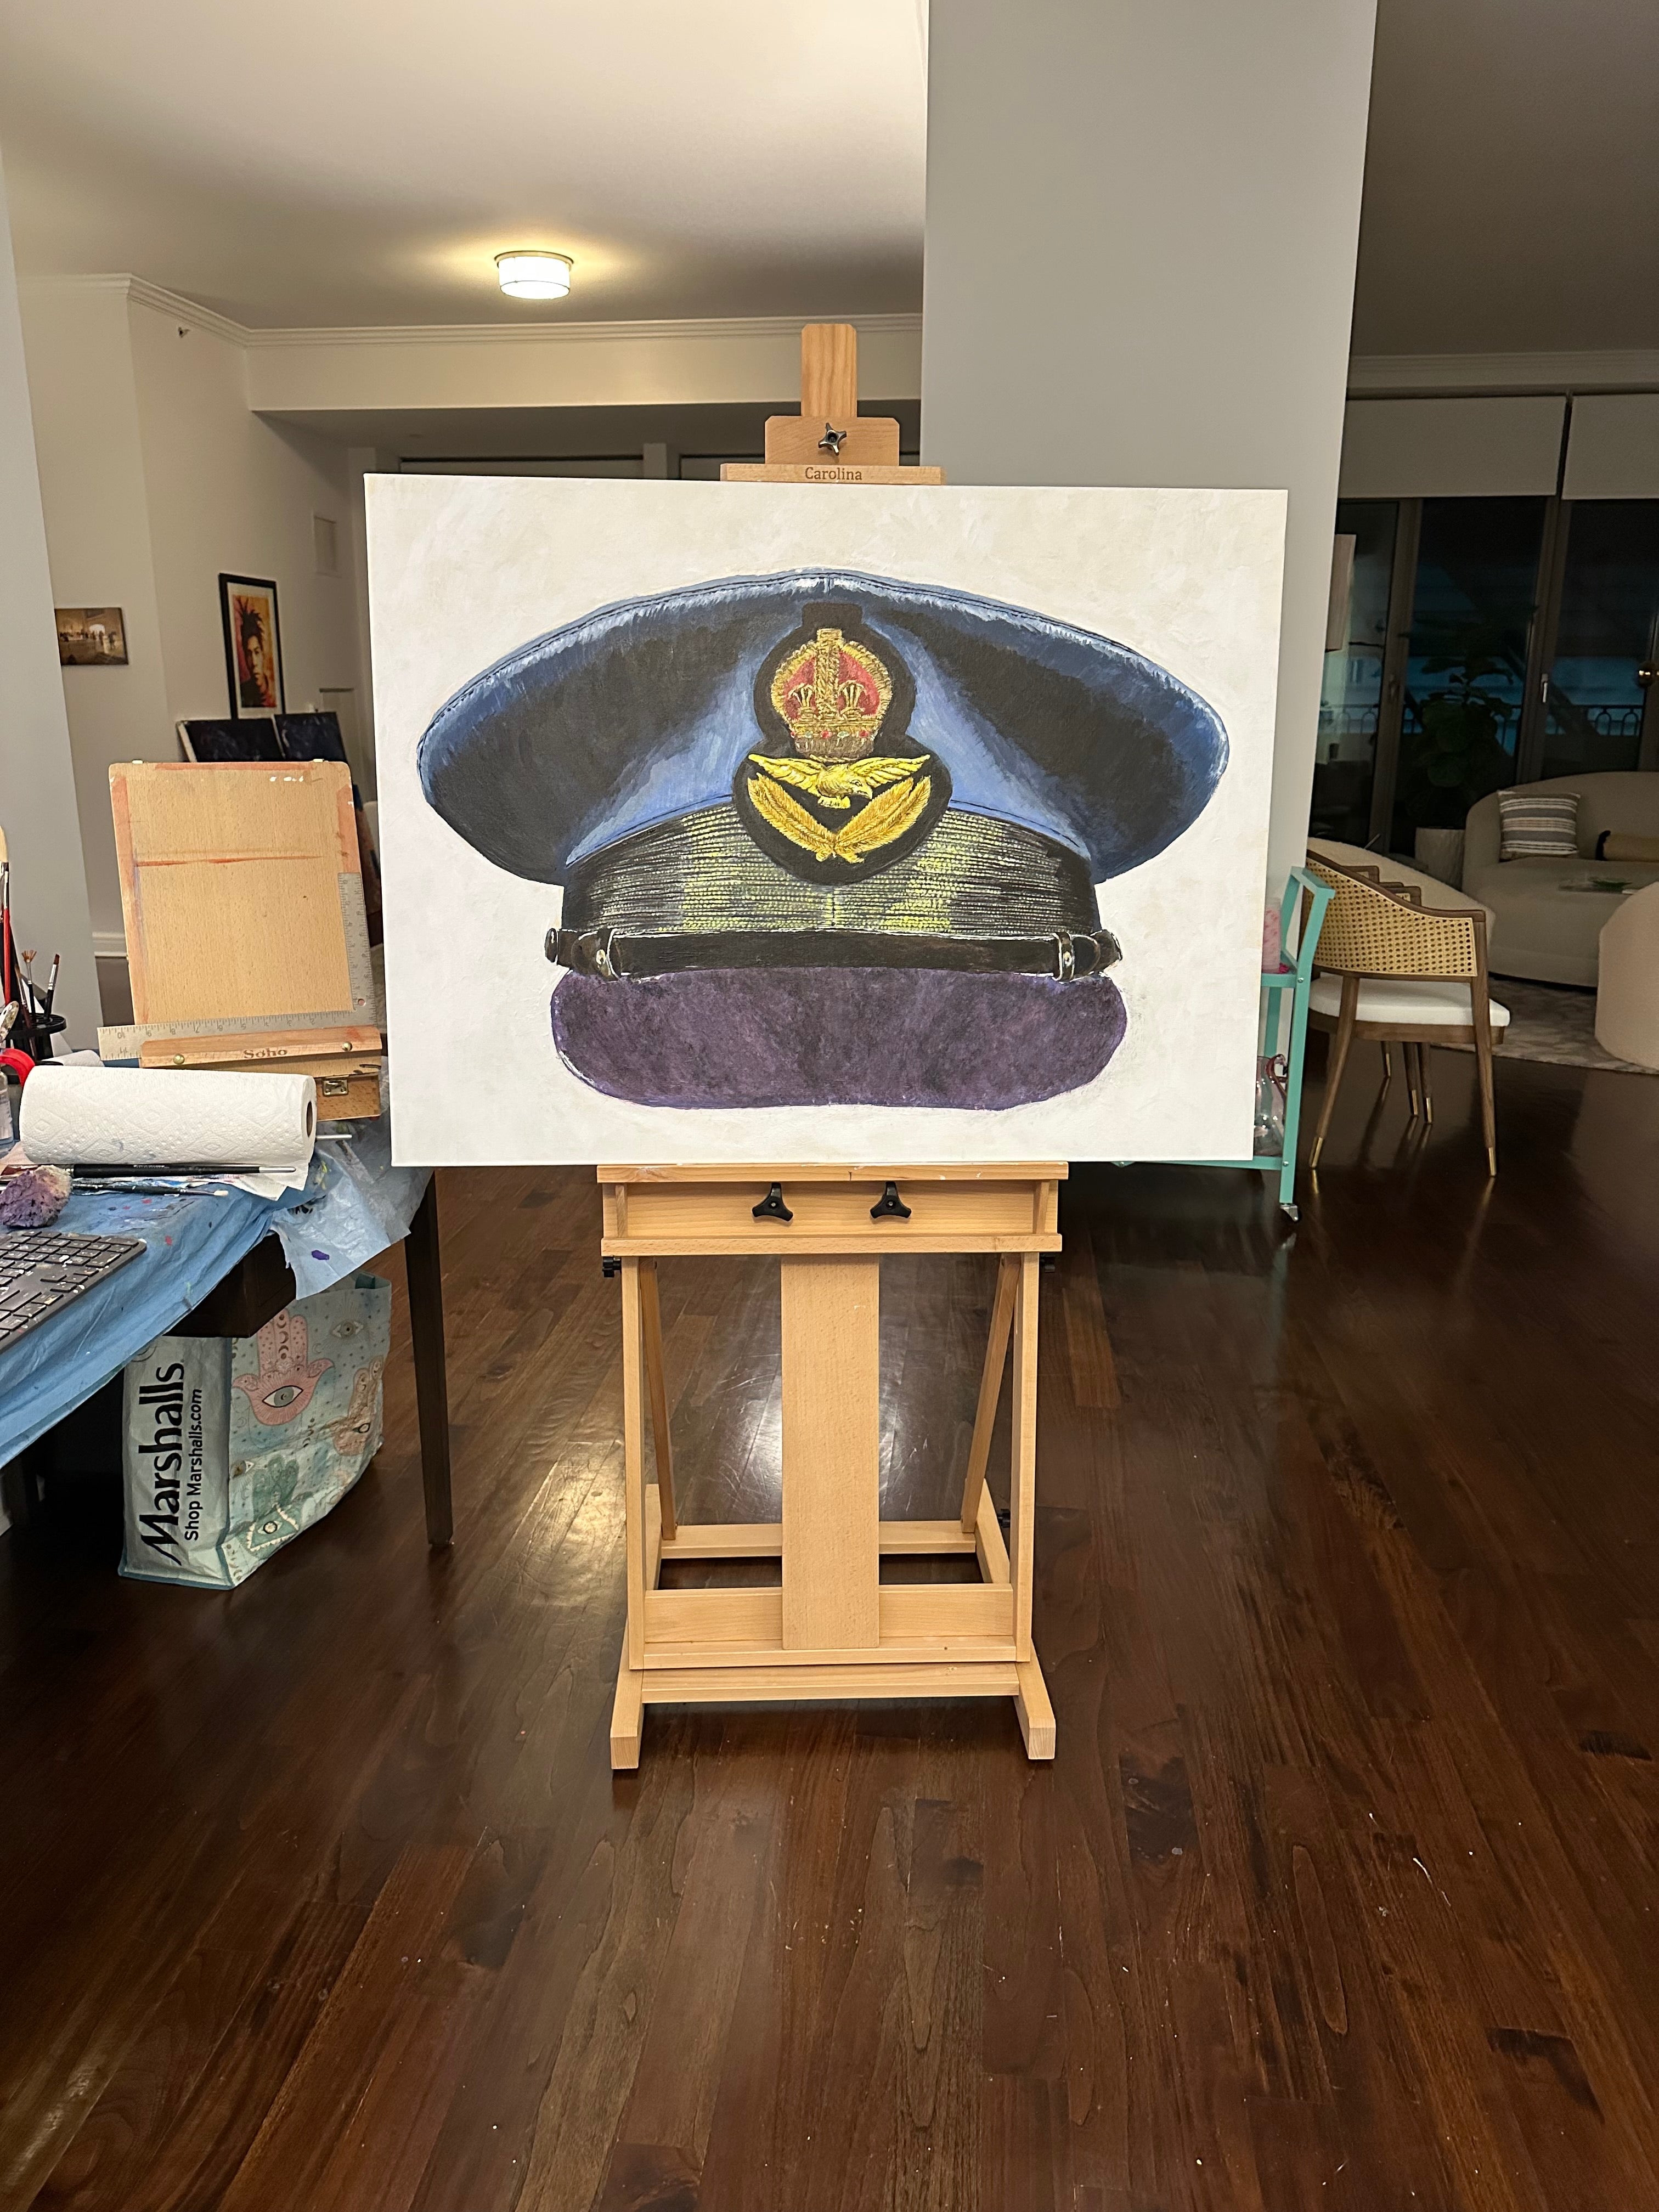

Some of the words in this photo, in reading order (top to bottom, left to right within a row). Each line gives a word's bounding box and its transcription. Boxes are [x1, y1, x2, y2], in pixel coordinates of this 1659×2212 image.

[805, 467, 862, 481] Carolina
[244, 1048, 287, 1059] Soho
[187, 1389, 202, 1496] Marshalls.com
[138, 1363, 184, 1566] Marshalls
[184, 1500, 204, 1541] Shop
